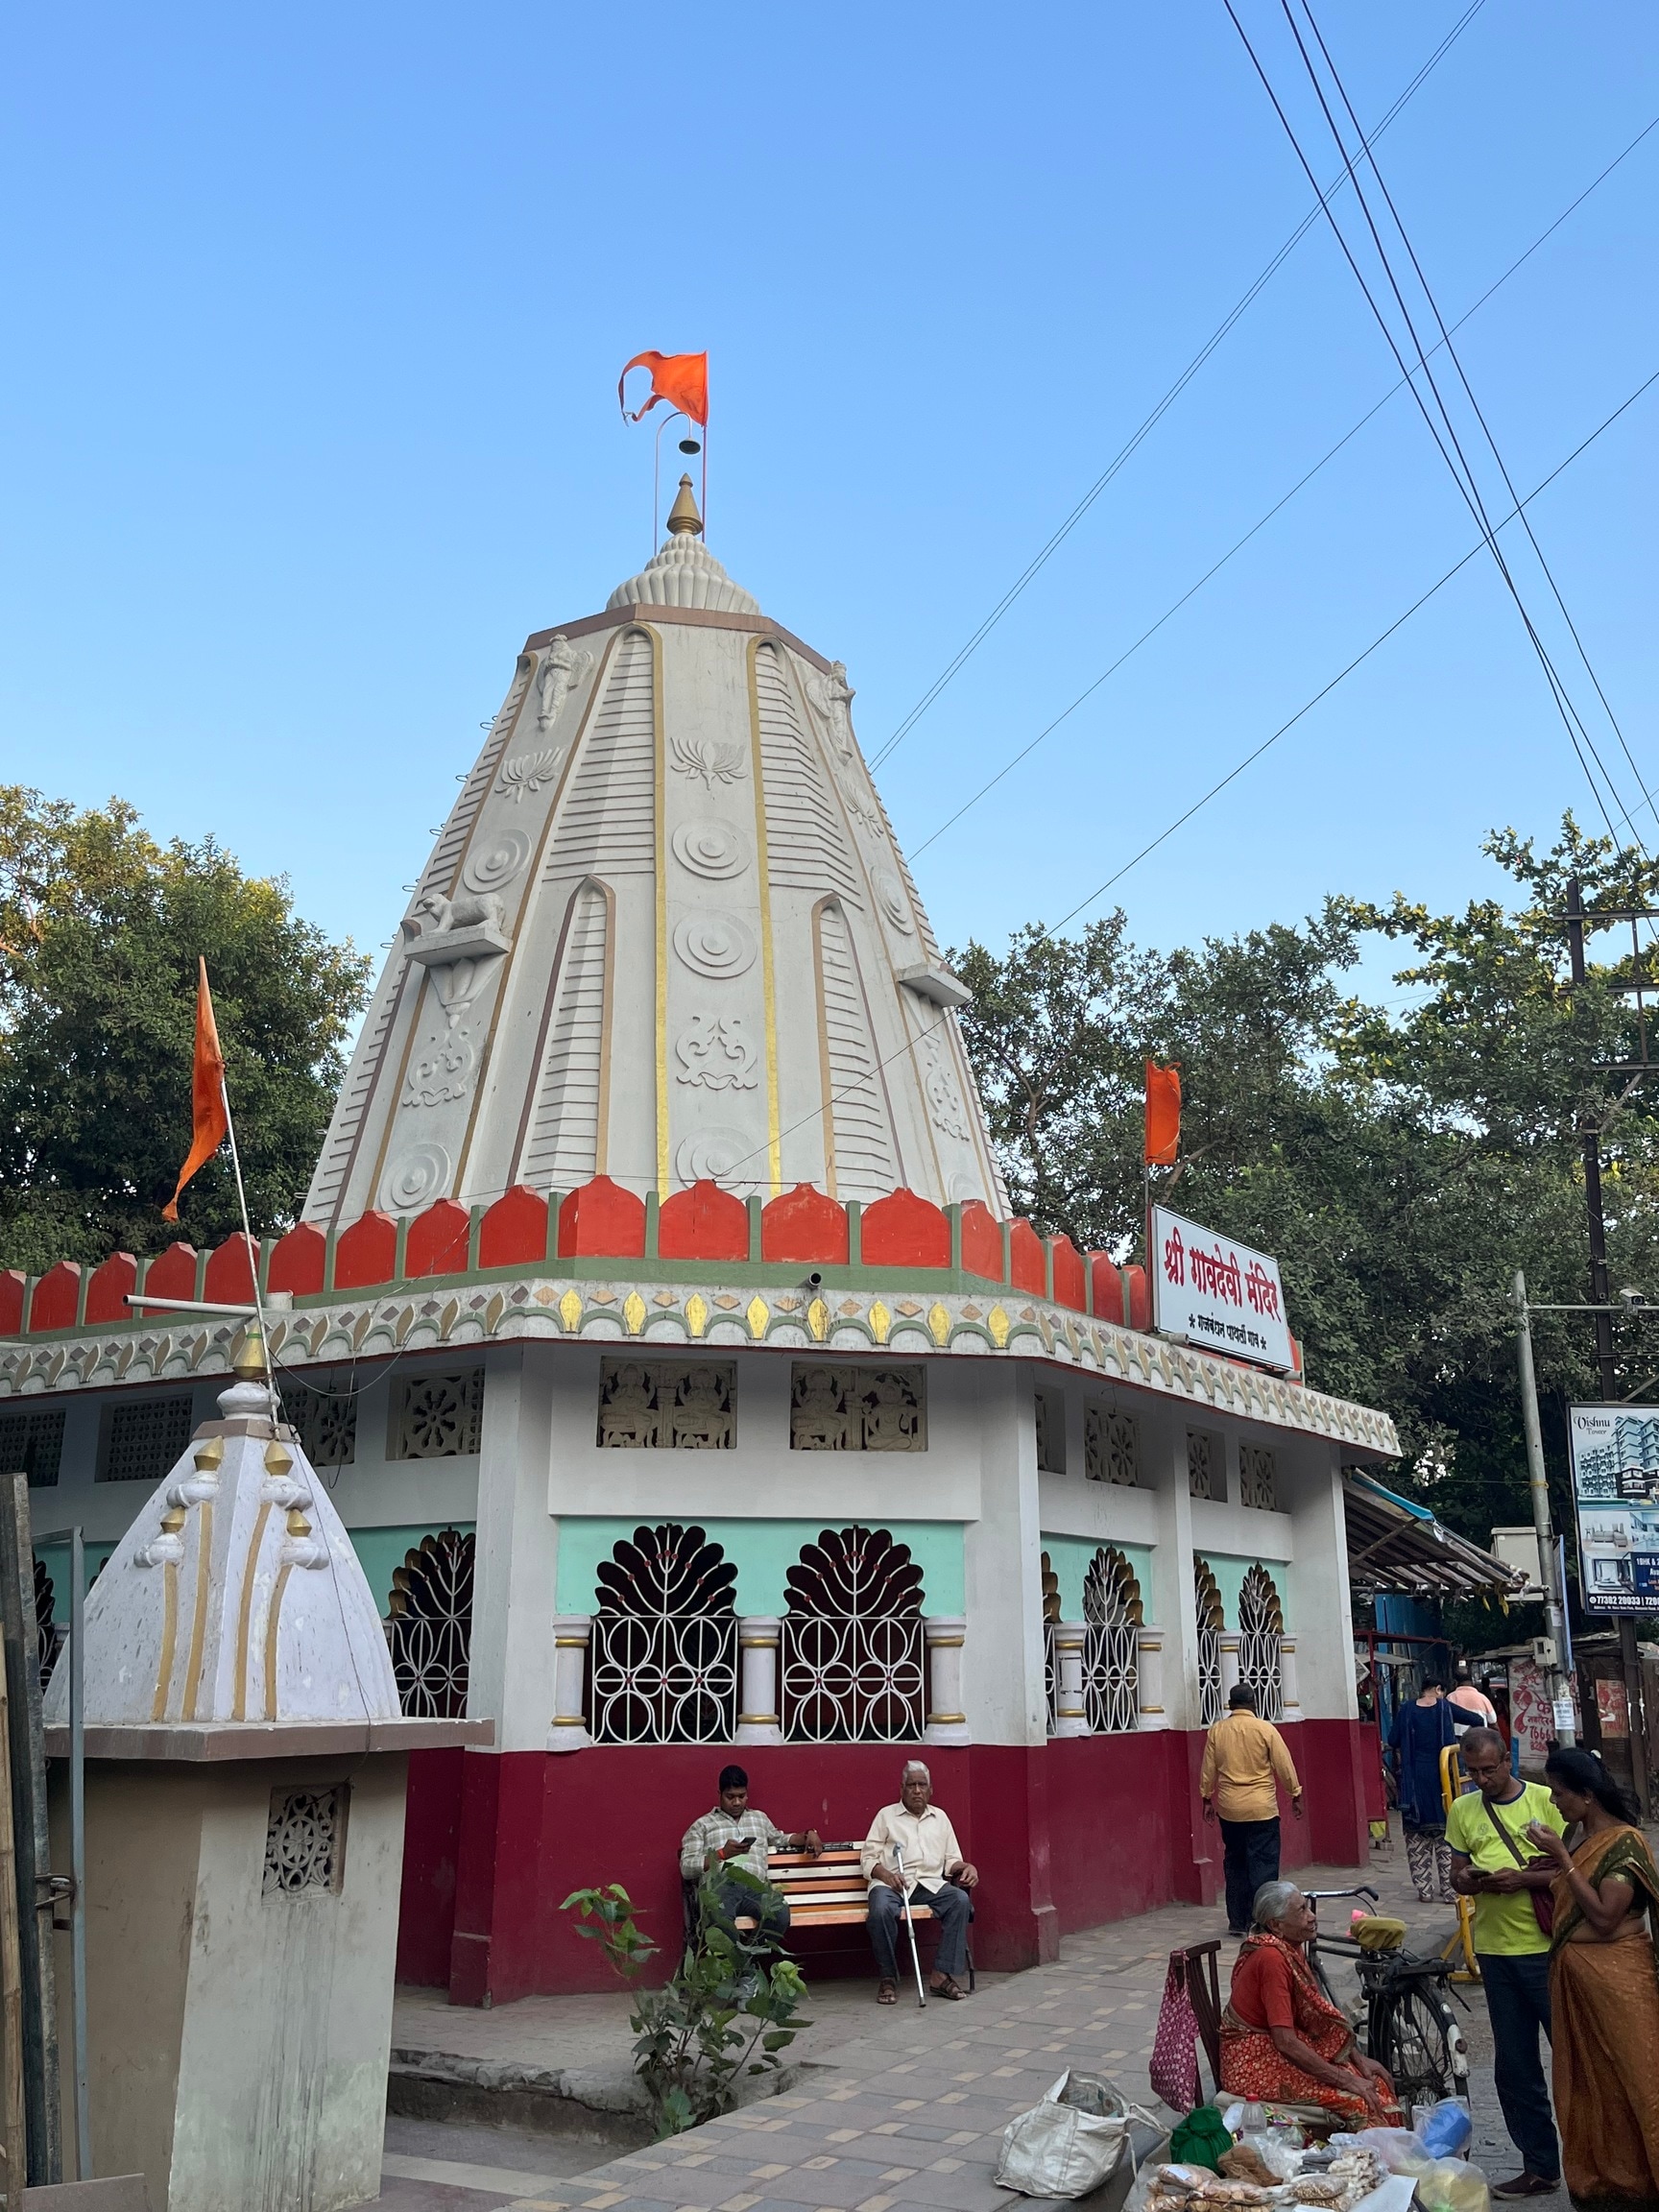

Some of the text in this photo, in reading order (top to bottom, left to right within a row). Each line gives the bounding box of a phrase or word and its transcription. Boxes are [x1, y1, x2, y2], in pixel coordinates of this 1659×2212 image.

[1165, 1226, 1282, 1323] श्री गावदेवी मंदिर
[1573, 1416, 1610, 1430] Vishnu
